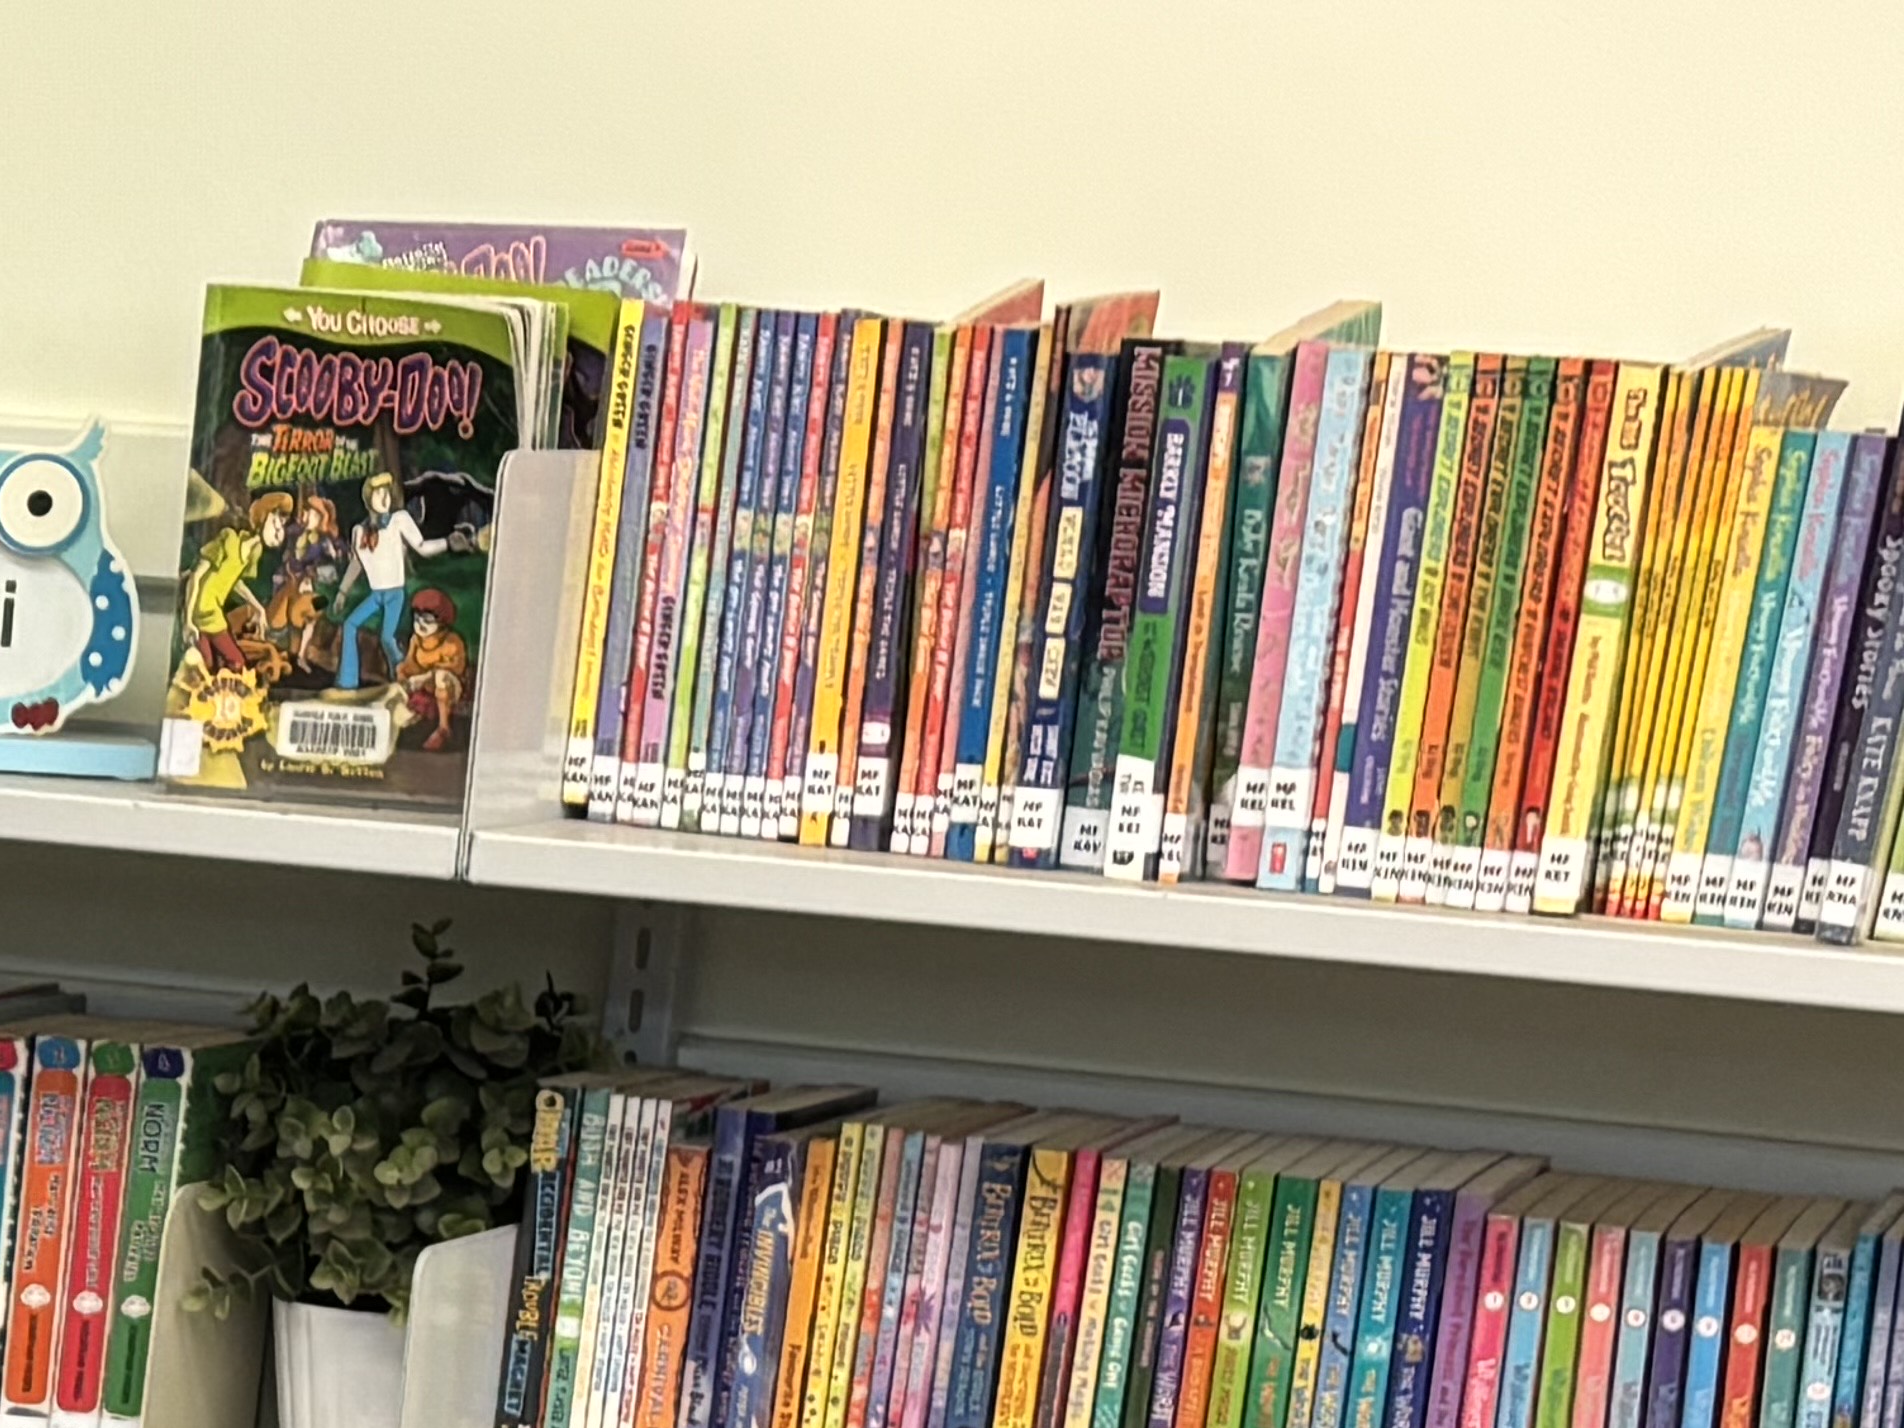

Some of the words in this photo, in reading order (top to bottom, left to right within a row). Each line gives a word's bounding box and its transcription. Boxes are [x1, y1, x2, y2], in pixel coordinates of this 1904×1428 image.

[305, 305, 344, 335] YOU
[345, 308, 422, 338] CHOOSE
[232, 333, 484, 442] SCOOBY-DOO!
[271, 423, 335, 454] TERROR
[245, 454, 329, 489] BIGFOOT
[1207, 1198, 1226, 1230] JILL
[1418, 1216, 1439, 1248] JILL
[1195, 1232, 1225, 1304] MURPHY
[1273, 1240, 1299, 1308] MURPHY
[1405, 1250, 1435, 1322] MURPHY
